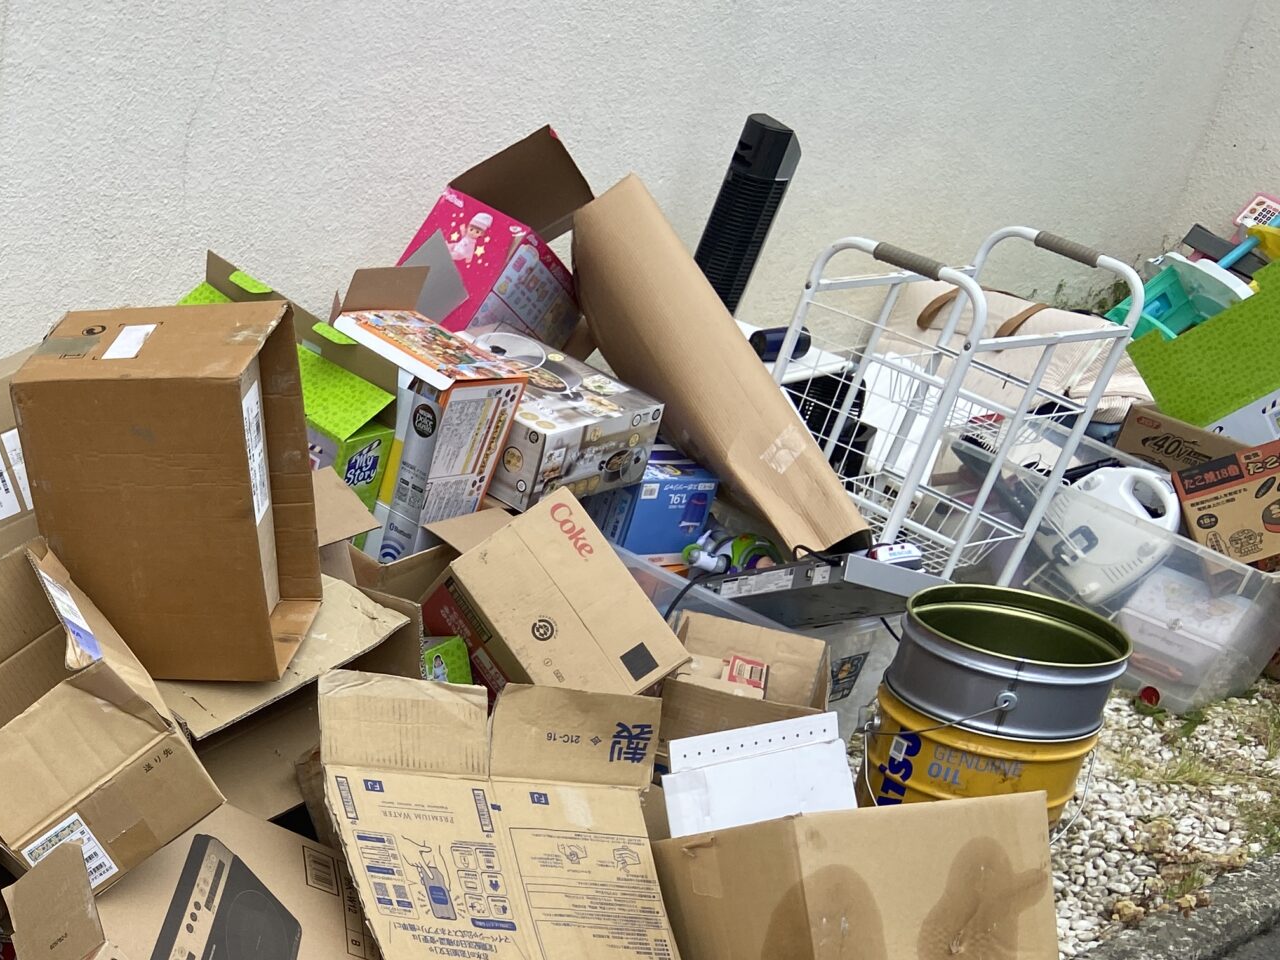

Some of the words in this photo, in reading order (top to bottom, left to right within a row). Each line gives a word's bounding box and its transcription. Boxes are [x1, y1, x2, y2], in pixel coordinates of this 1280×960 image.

[354, 453, 374, 470] My
[1247, 455, 1280, 475] たこ
[345, 465, 376, 486] Story
[550, 502, 594, 559] Coke
[546, 732, 582, 745] 21C-16
[143, 748, 173, 773] 送り先
[934, 745, 1024, 778] GENUINE
[927, 762, 960, 785] OIL
[381, 810, 414, 821] WATER
[415, 814, 455, 825] PREMIUM
